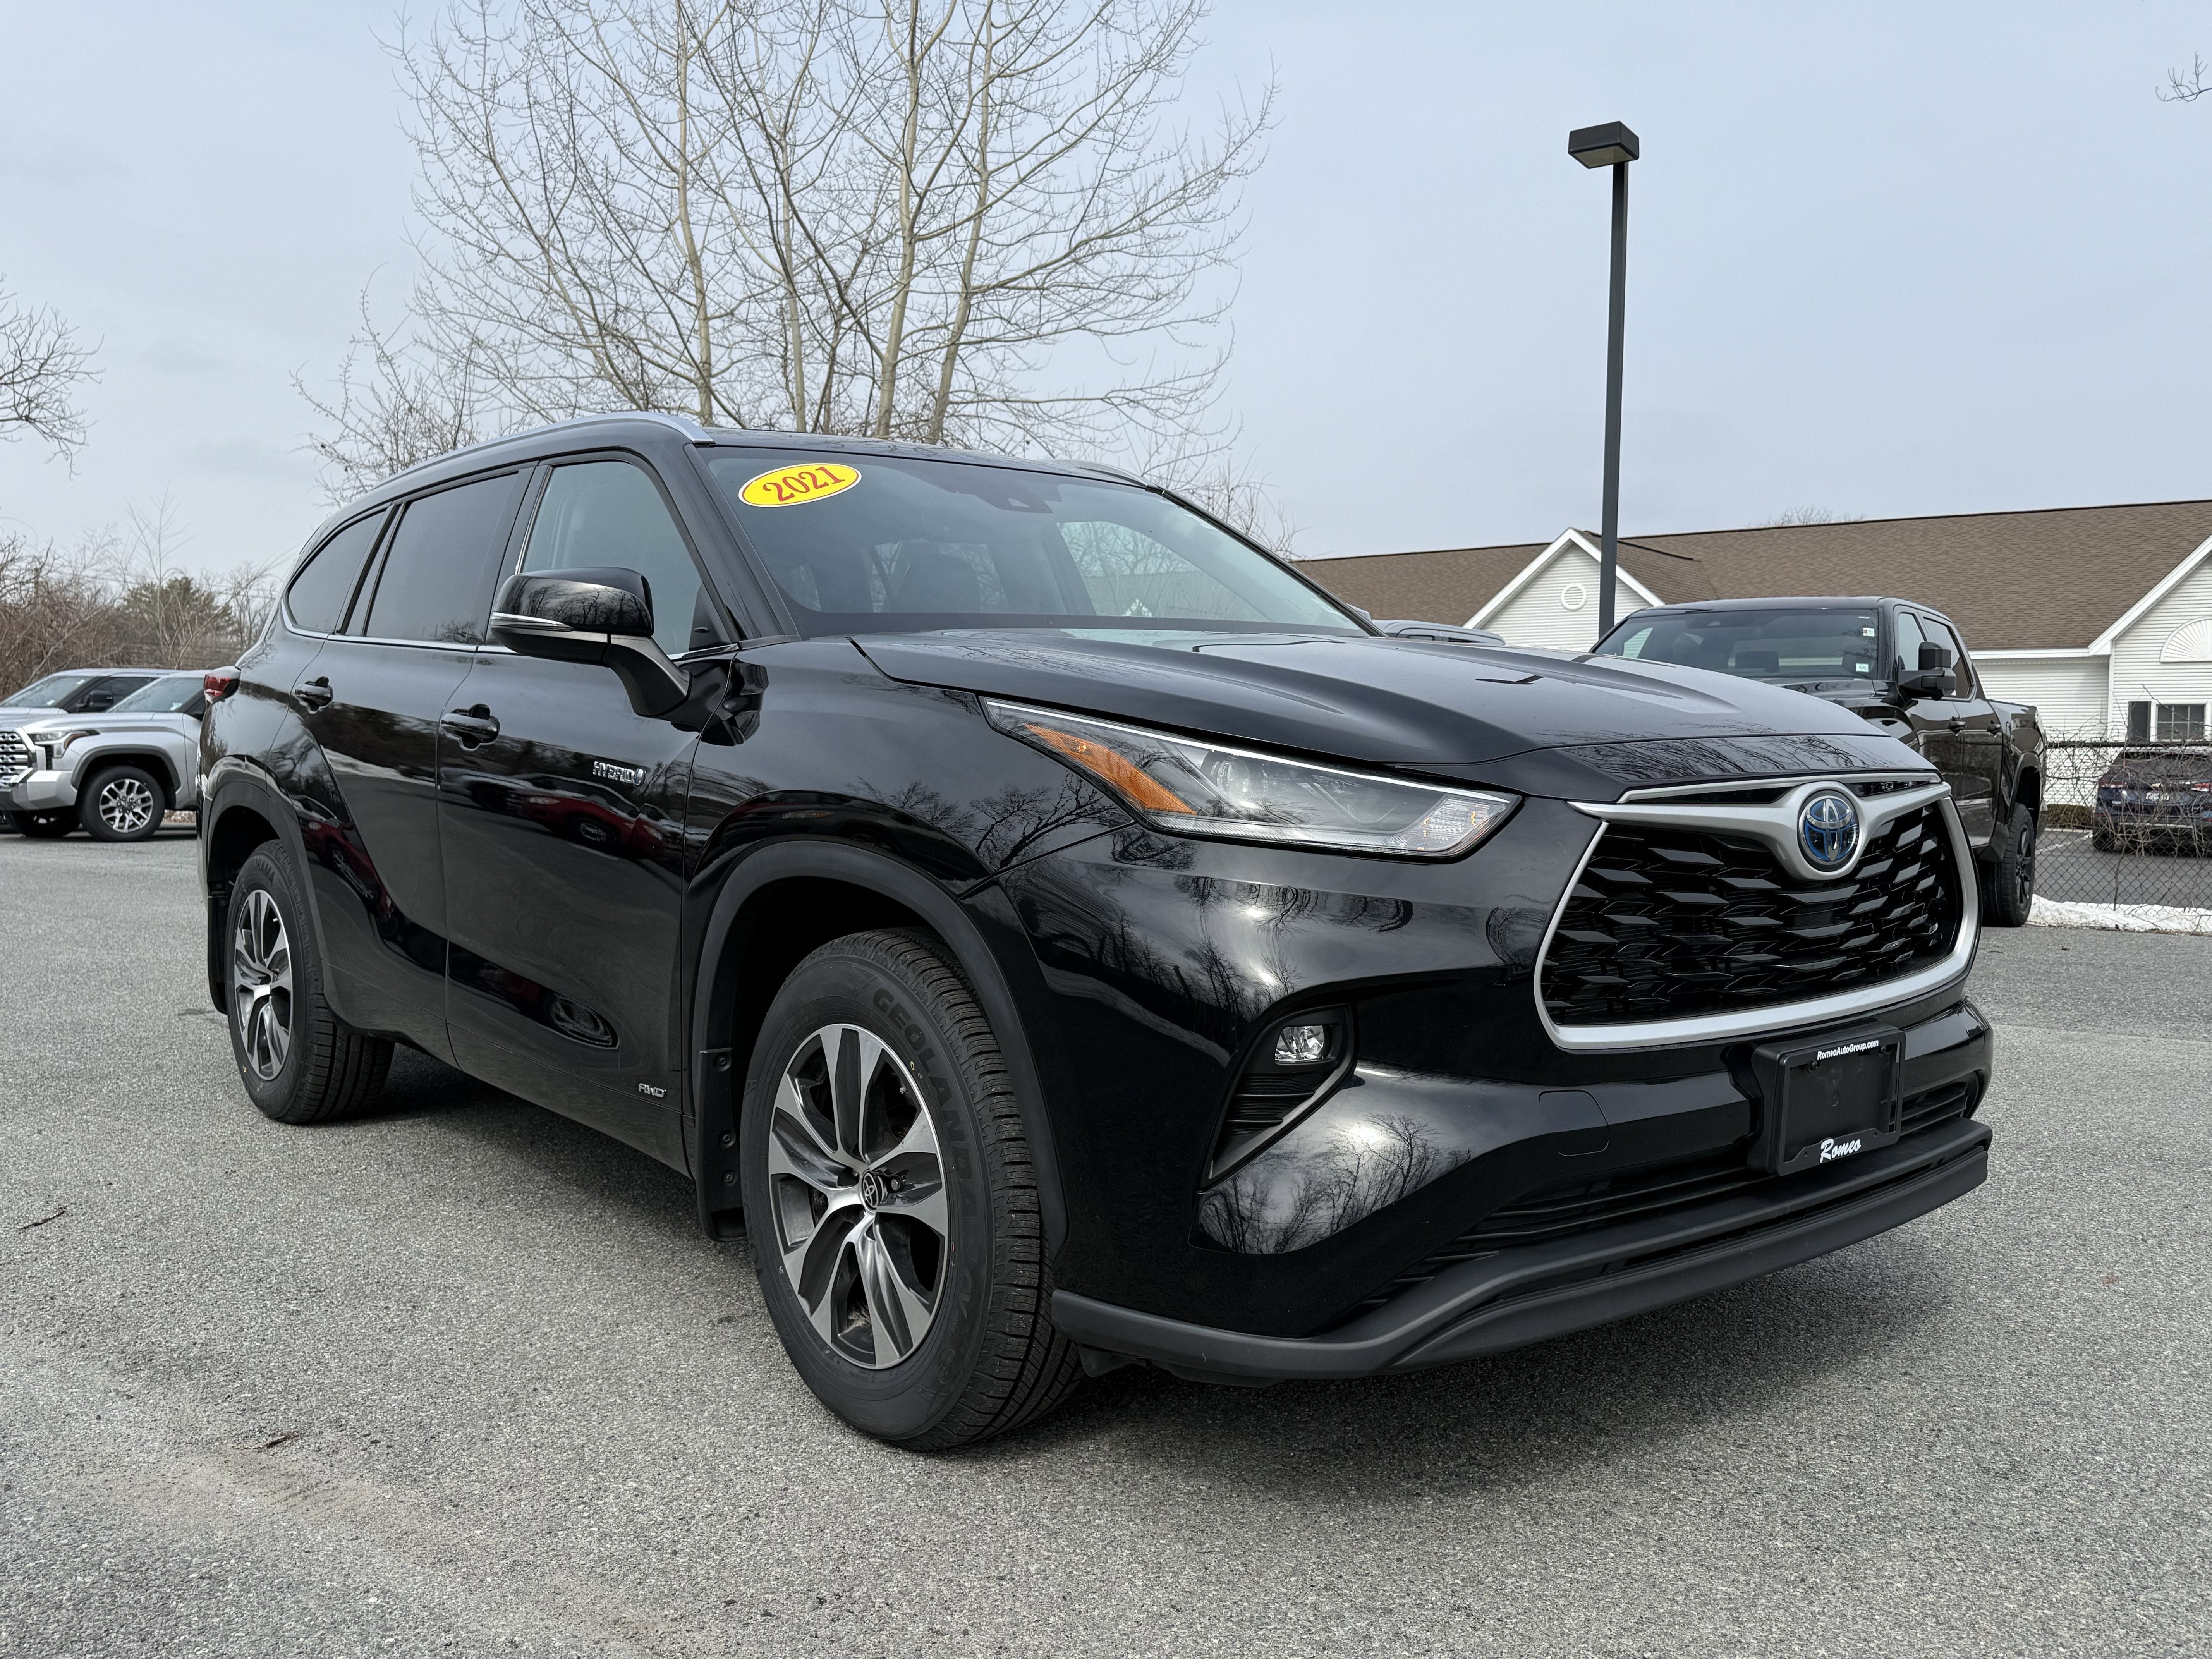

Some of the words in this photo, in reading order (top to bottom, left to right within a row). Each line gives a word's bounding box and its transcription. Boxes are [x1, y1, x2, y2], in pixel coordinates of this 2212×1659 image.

[763, 466, 845, 502] 2021
[592, 761, 636, 785] HYBRID
[1817, 1040, 1879, 1061] RomeoAutoGroup.com
[638, 1083, 664, 1098] AWD
[1819, 1137, 1862, 1163] Romeo
